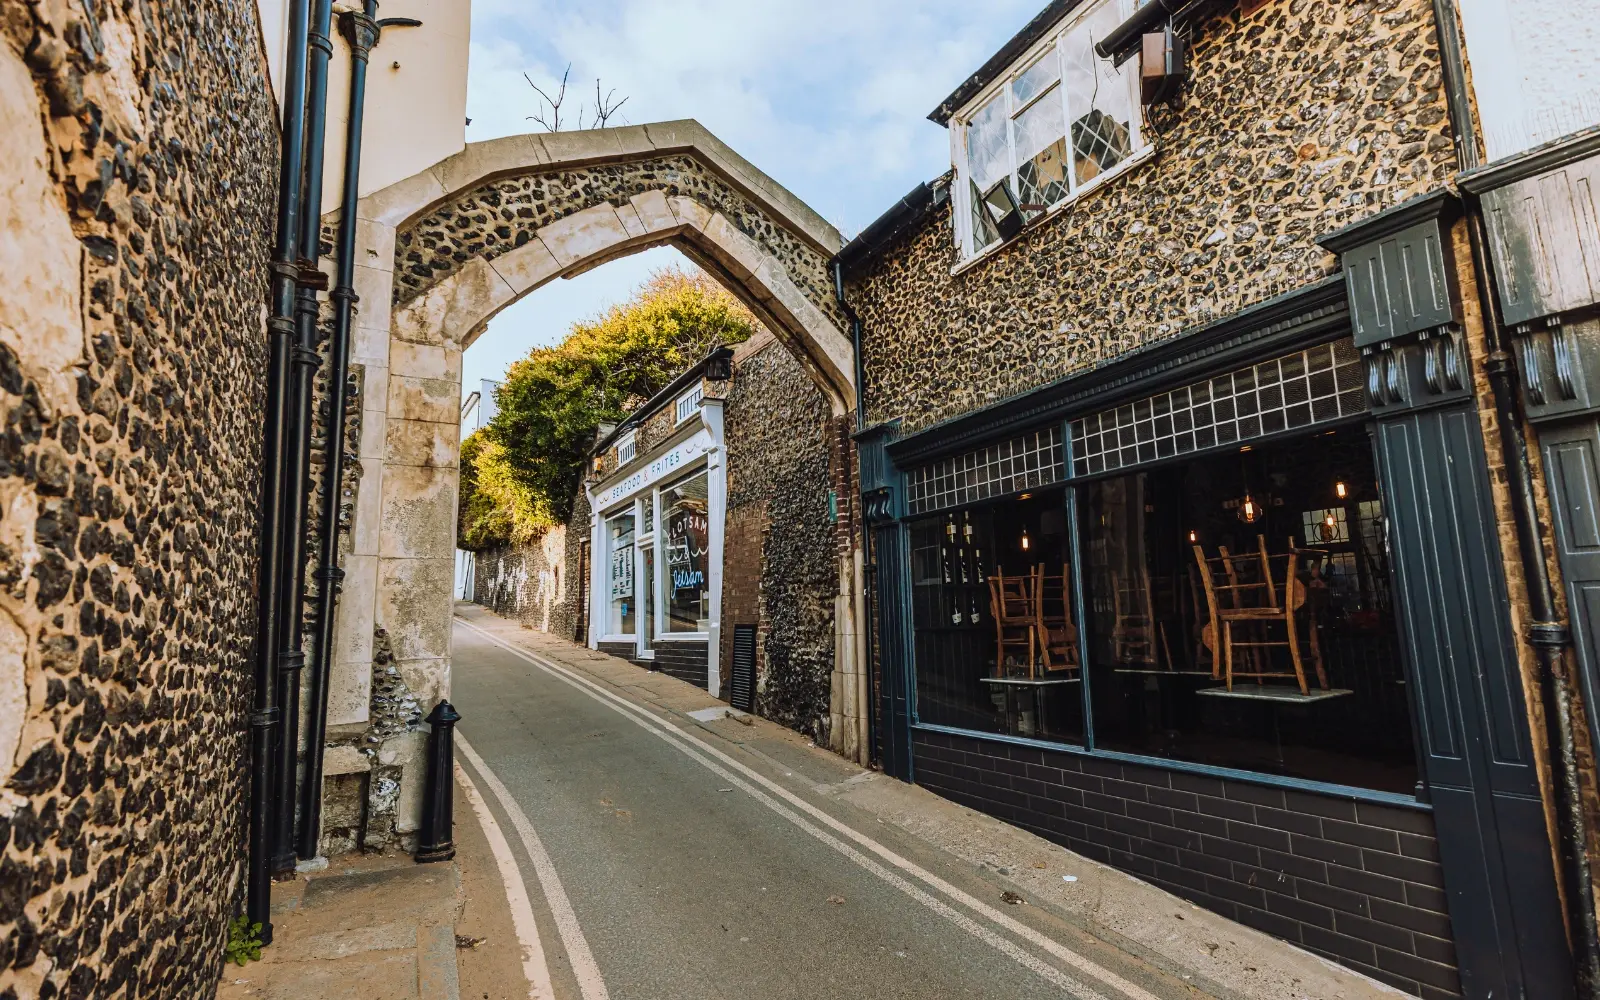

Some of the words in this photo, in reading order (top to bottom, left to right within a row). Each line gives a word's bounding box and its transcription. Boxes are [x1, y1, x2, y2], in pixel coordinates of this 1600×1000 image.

[612, 475, 641, 499] SEAFOOD
[643, 469, 648, 482] &
[651, 451, 680, 476] FRITES
[667, 516, 707, 545] FLOTSAM
